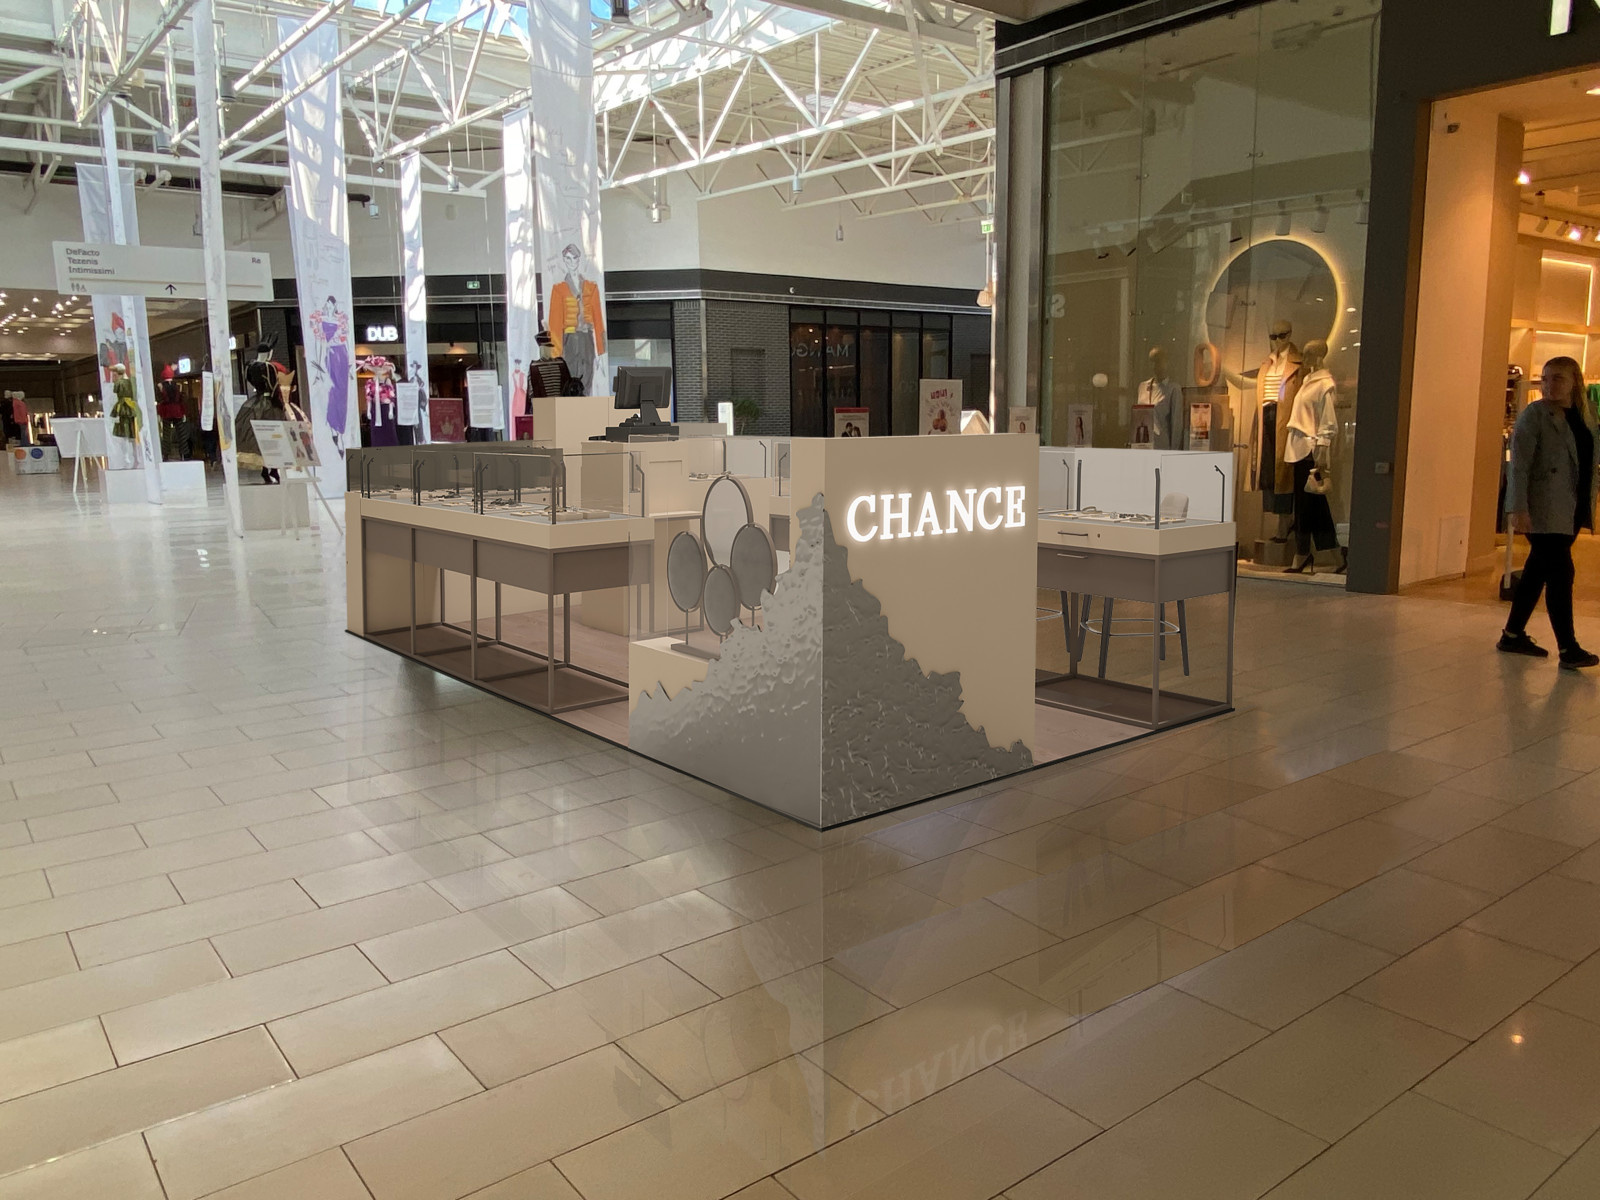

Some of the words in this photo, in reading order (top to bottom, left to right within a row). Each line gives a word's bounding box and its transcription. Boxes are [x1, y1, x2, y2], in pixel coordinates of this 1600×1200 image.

[65, 247, 100, 256] DeFacto
[67, 256, 99, 265] Tezenis
[68, 266, 116, 275] Intimissimi
[367, 326, 399, 341] DUB
[846, 485, 1026, 543] CHANCE
